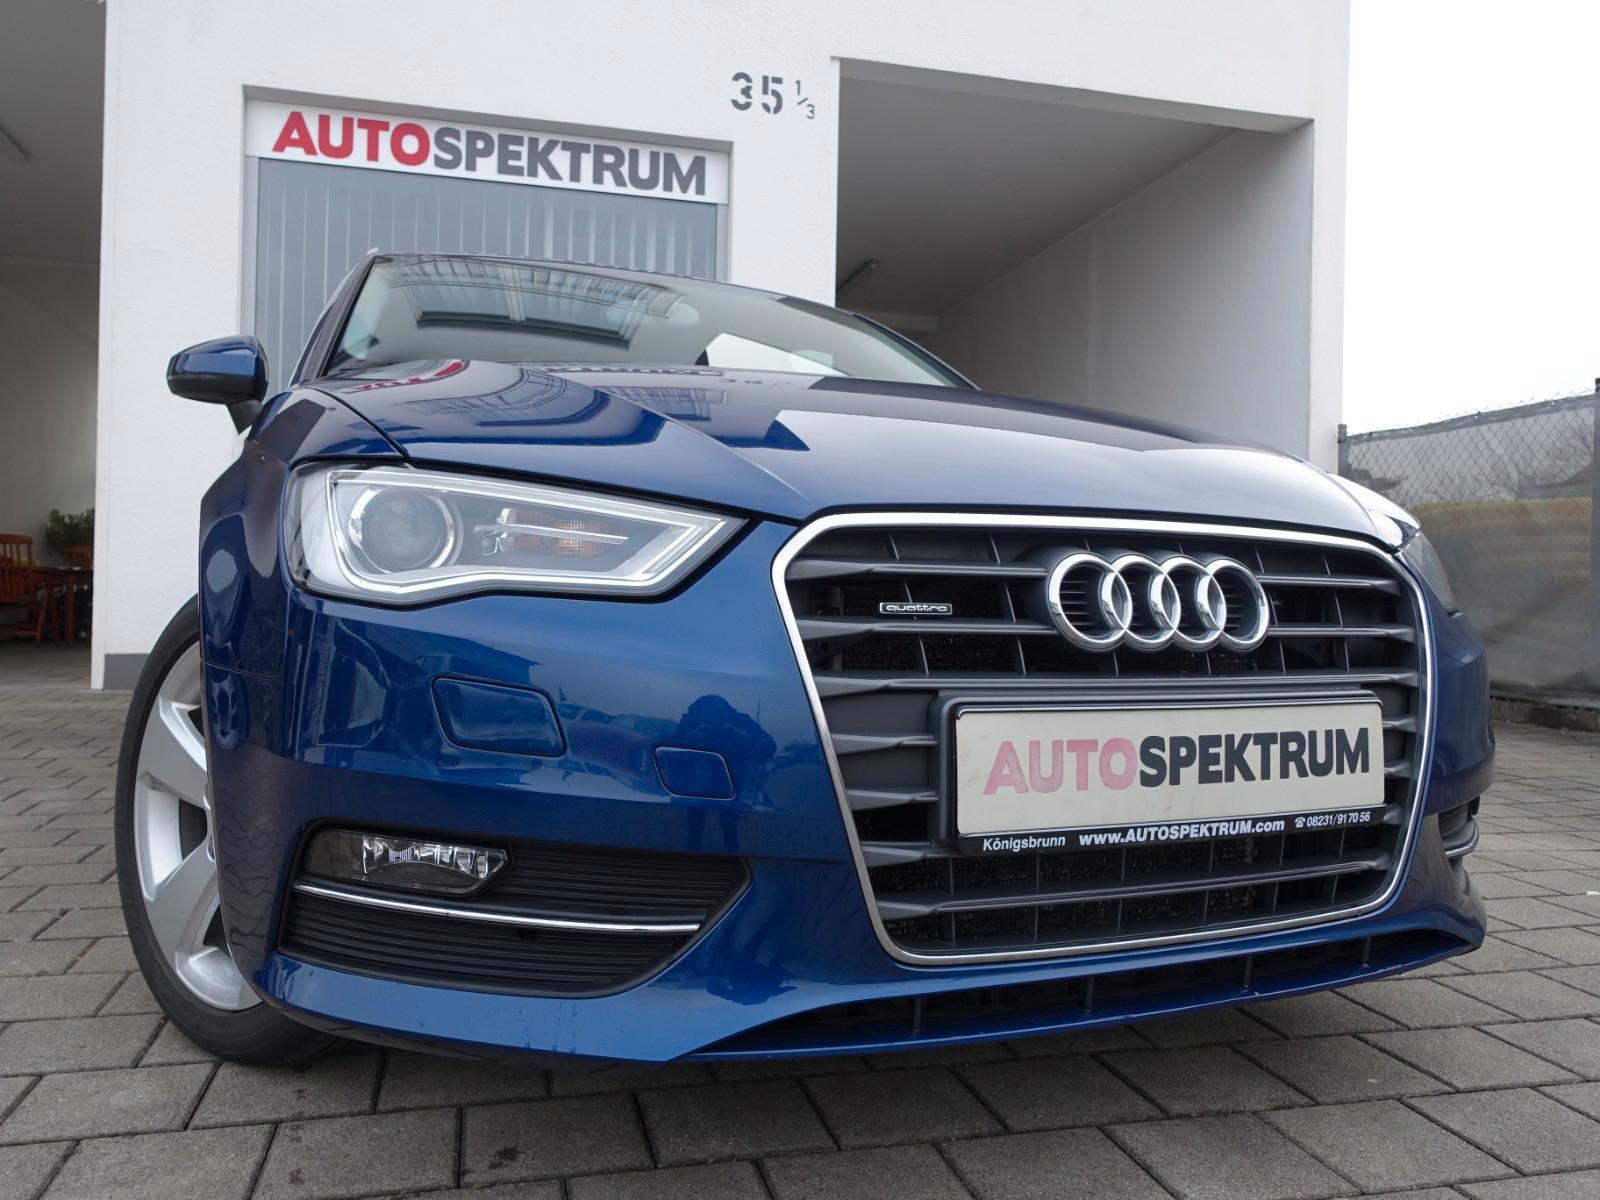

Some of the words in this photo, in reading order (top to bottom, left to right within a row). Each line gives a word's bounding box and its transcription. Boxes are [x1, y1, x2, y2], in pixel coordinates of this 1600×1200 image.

[731, 72, 783, 114] 35
[886, 604, 947, 612] quattro
[983, 836, 1066, 852] Königsbrunn
[1079, 819, 1285, 846] www.AUTOSPEKTRUM.com
